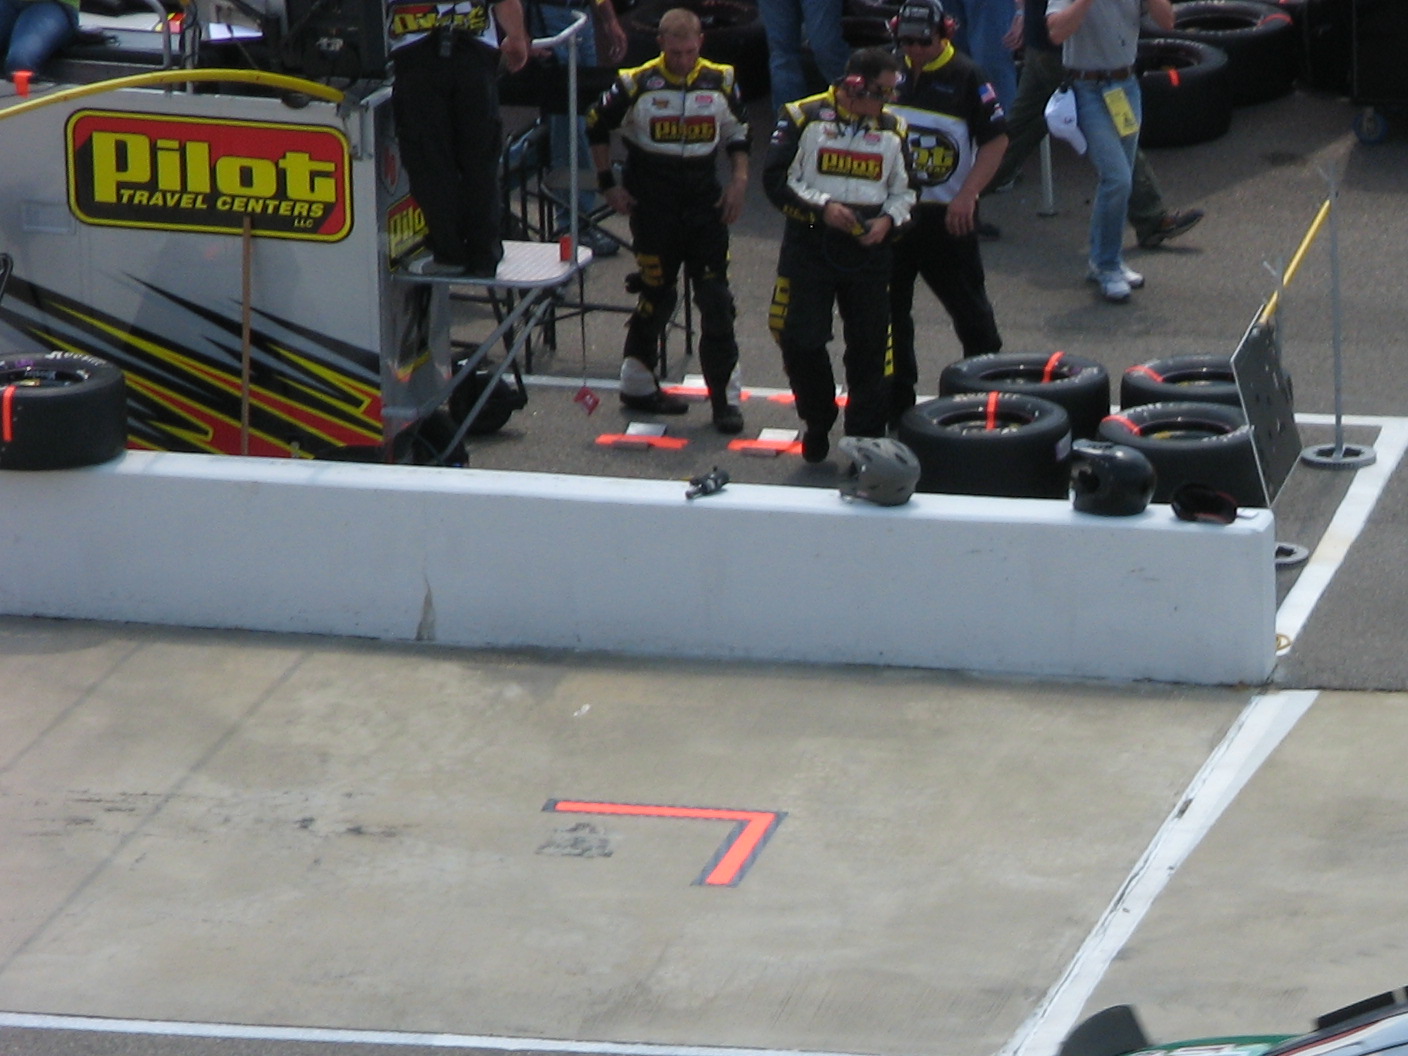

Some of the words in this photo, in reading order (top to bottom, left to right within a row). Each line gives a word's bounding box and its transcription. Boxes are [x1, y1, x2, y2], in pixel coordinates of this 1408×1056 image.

[92, 130, 337, 204] Pilot
[119, 188, 209, 209] TRAVEL
[215, 195, 325, 218] CENTERS
[293, 218, 314, 228] LLC
[389, 205, 427, 259] Pilo
